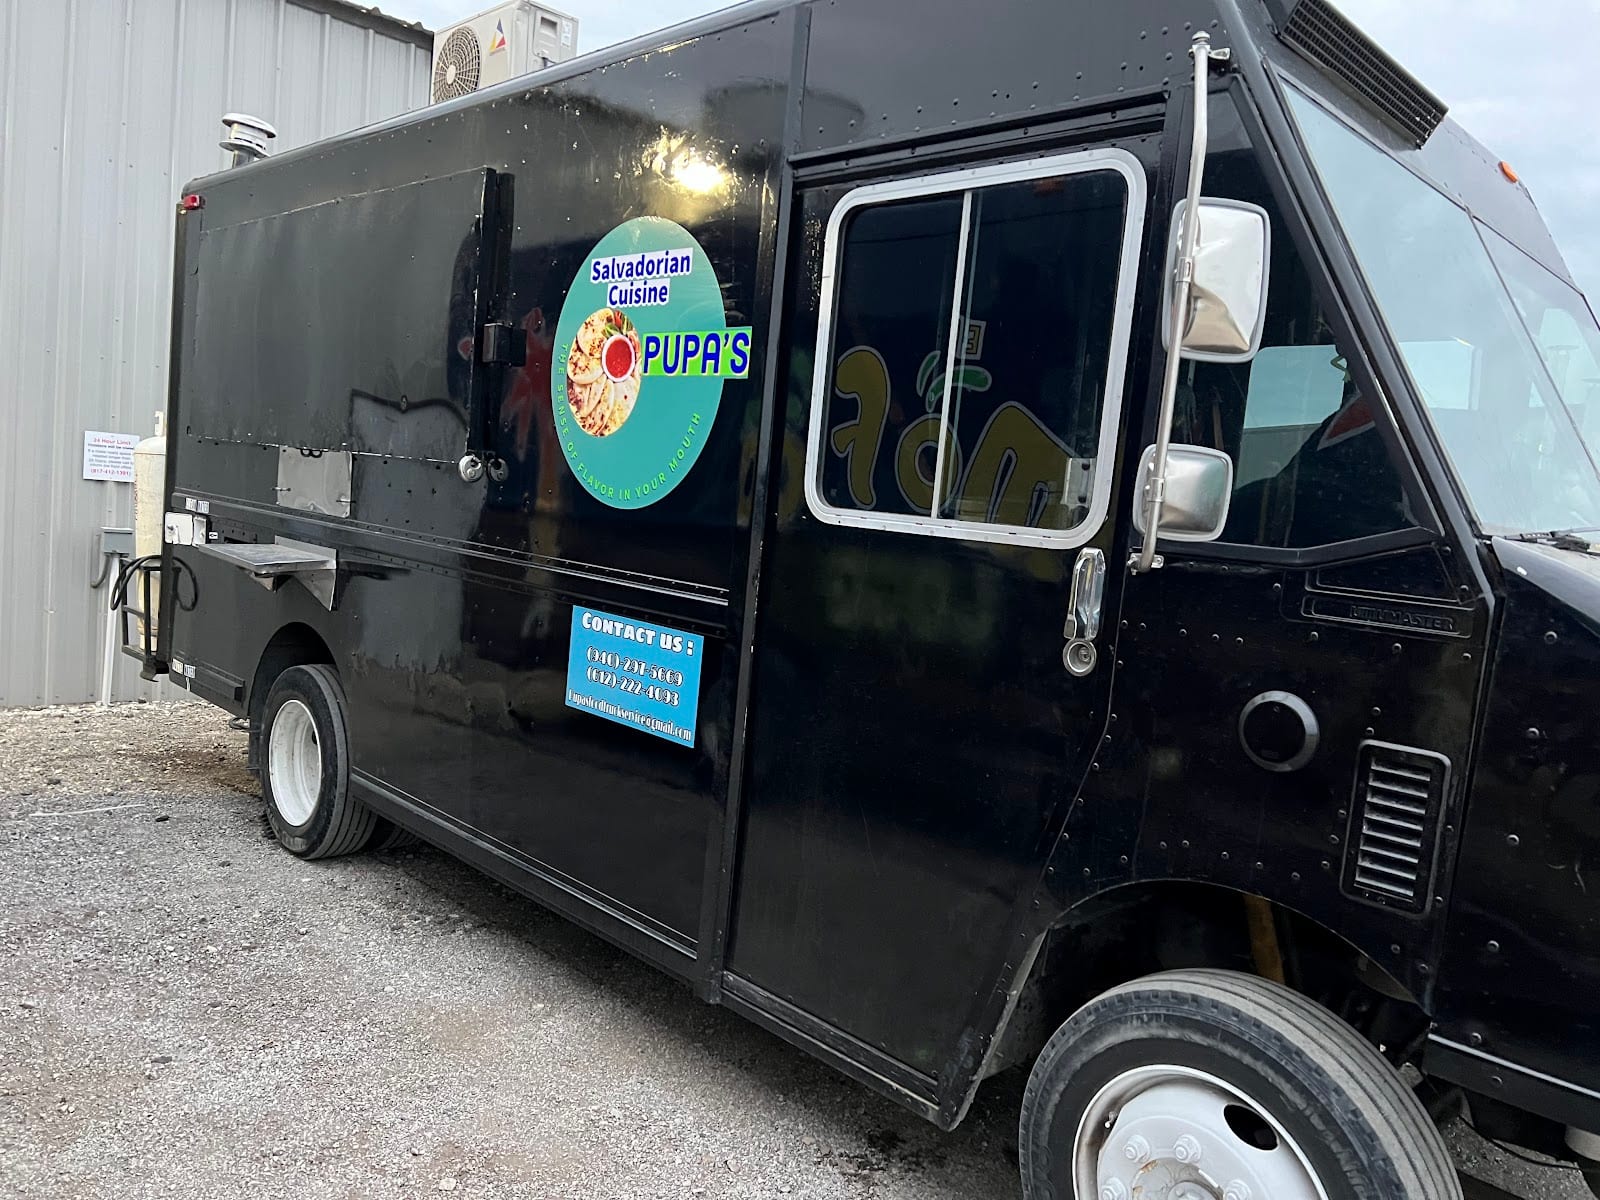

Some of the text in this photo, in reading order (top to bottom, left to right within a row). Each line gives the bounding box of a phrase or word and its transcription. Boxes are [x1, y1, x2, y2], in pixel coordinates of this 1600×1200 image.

[591, 250, 691, 282] Salvadorian
[608, 281, 668, 306] Cuisine
[644, 332, 751, 376] PUPA'S
[556, 343, 702, 501] THE SENSE OF FLAVOR IN YOUR MOUTH
